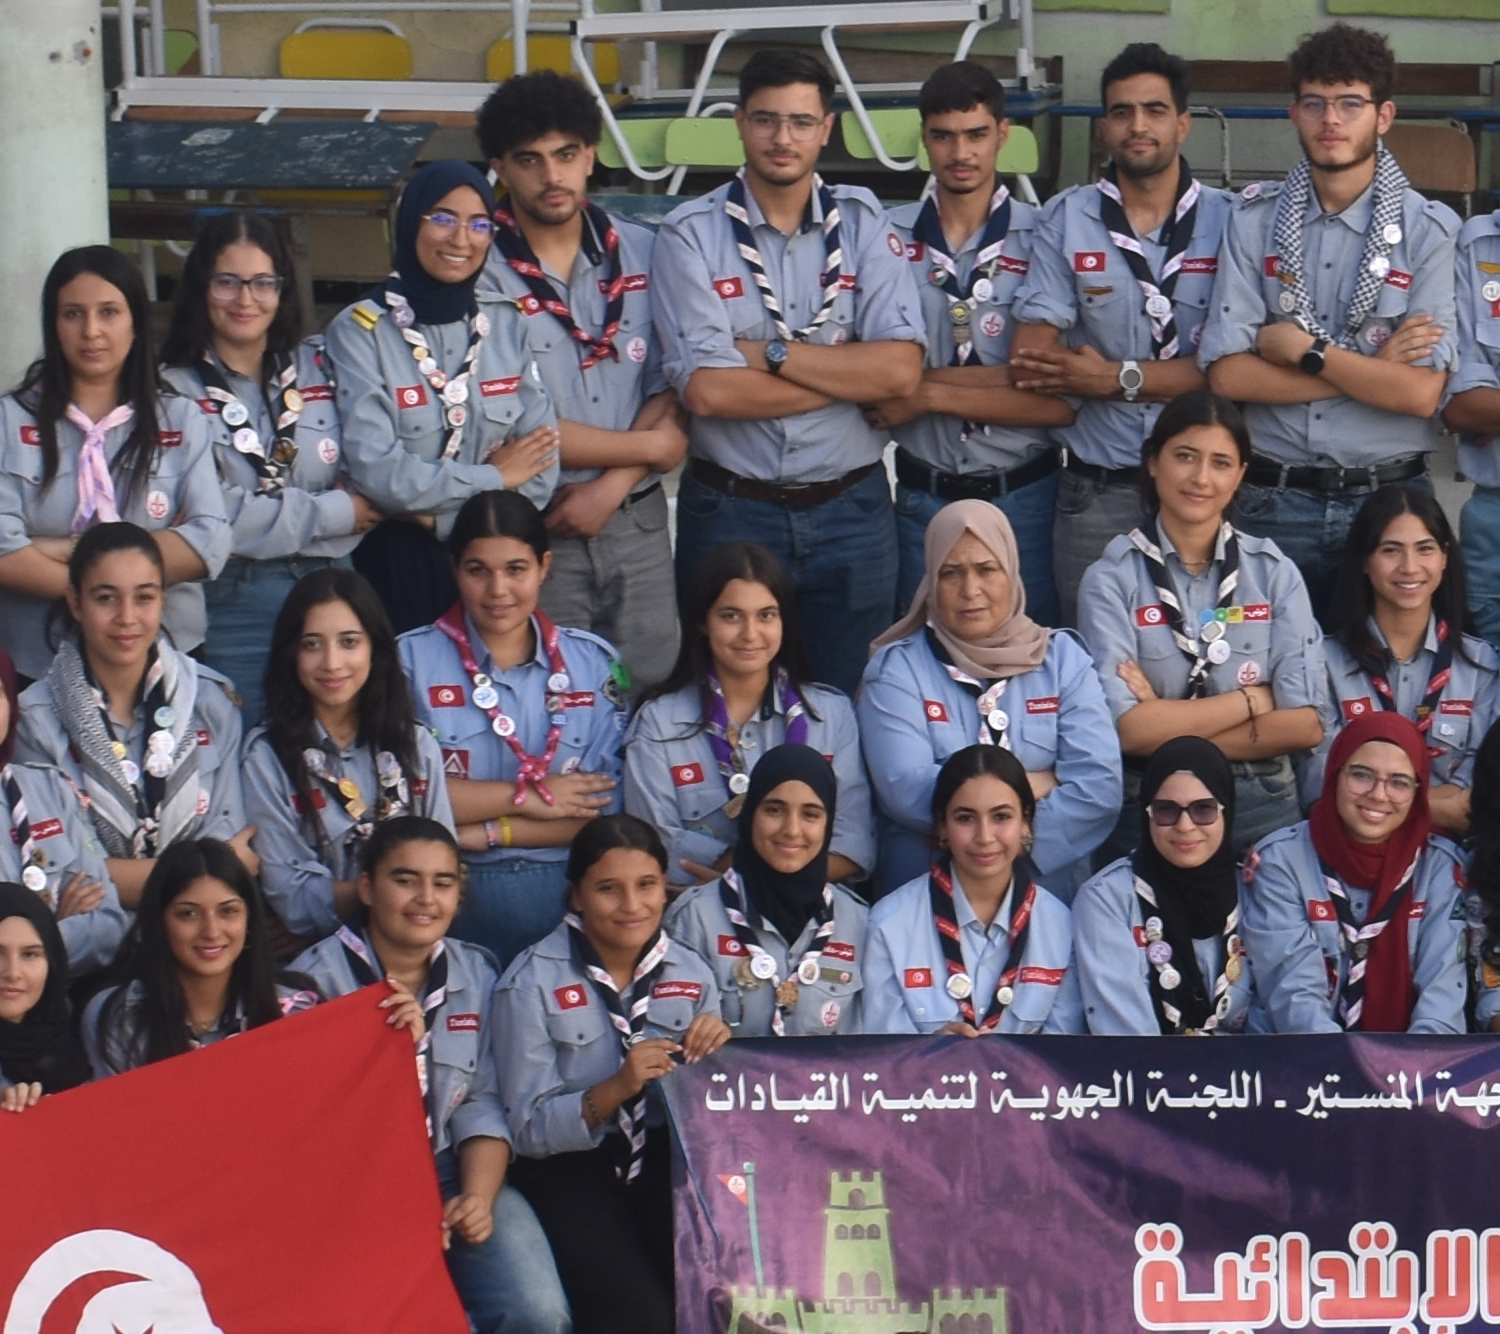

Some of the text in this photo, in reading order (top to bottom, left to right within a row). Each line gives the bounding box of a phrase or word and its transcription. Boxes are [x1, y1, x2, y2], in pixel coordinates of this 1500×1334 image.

[704, 1069, 850, 1124] القيادات
[862, 1070, 978, 1123] لتنمية
[991, 1069, 1134, 1122] الجهوية
[1145, 1070, 1263, 1120] اللجنة
[1295, 1069, 1423, 1120] المنستير
